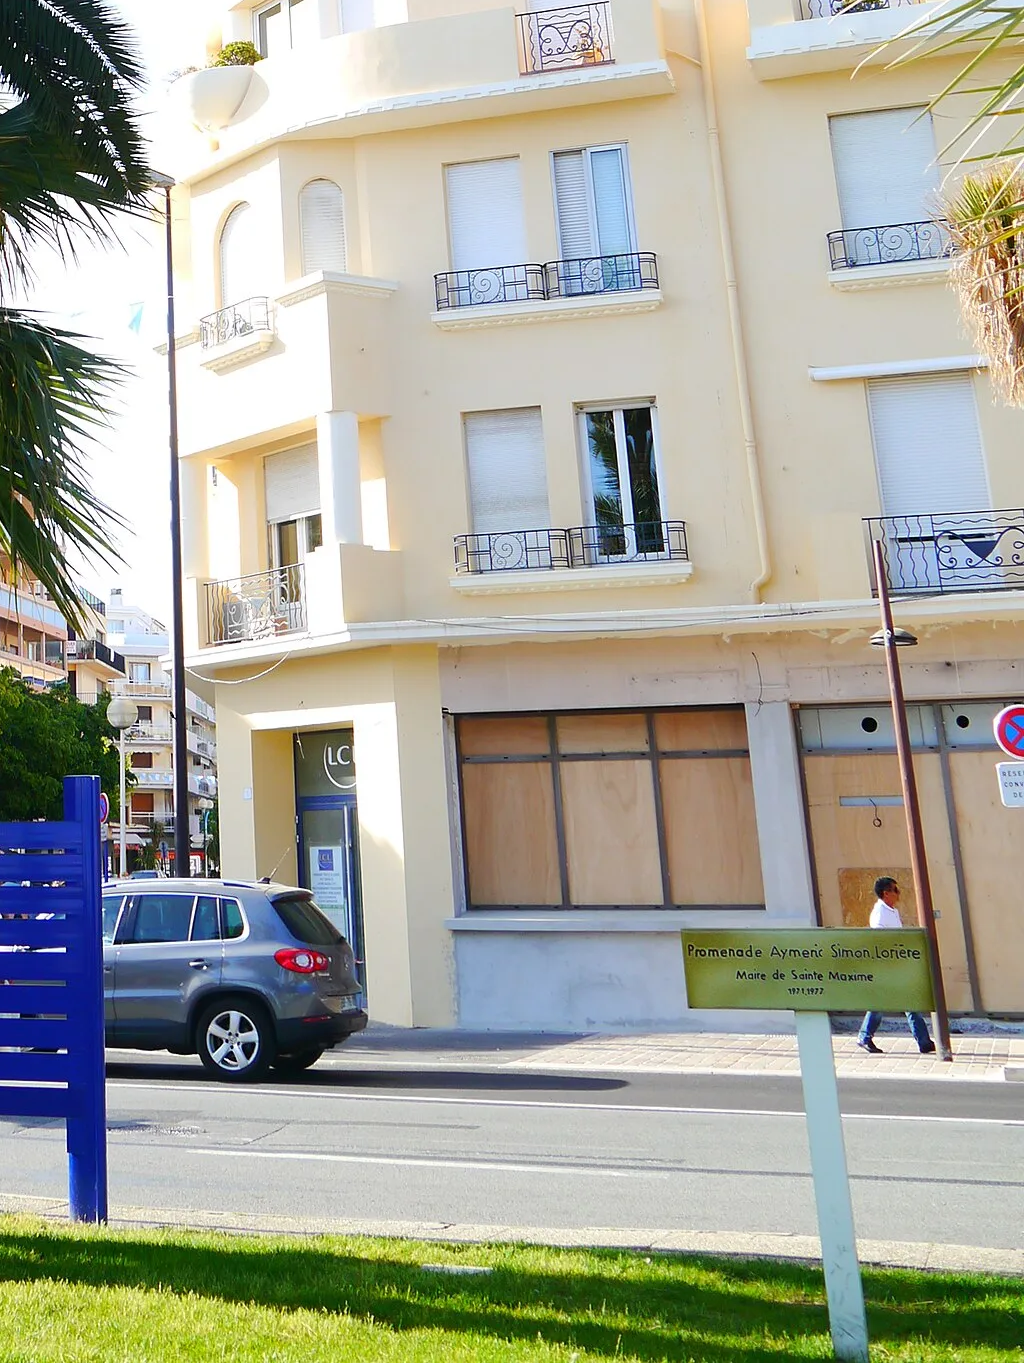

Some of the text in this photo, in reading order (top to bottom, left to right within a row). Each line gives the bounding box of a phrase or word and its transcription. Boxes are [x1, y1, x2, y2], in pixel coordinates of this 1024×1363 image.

[687, 944, 763, 958] Promenade
[736, 969, 874, 982] Maire de Sainte Maxime
